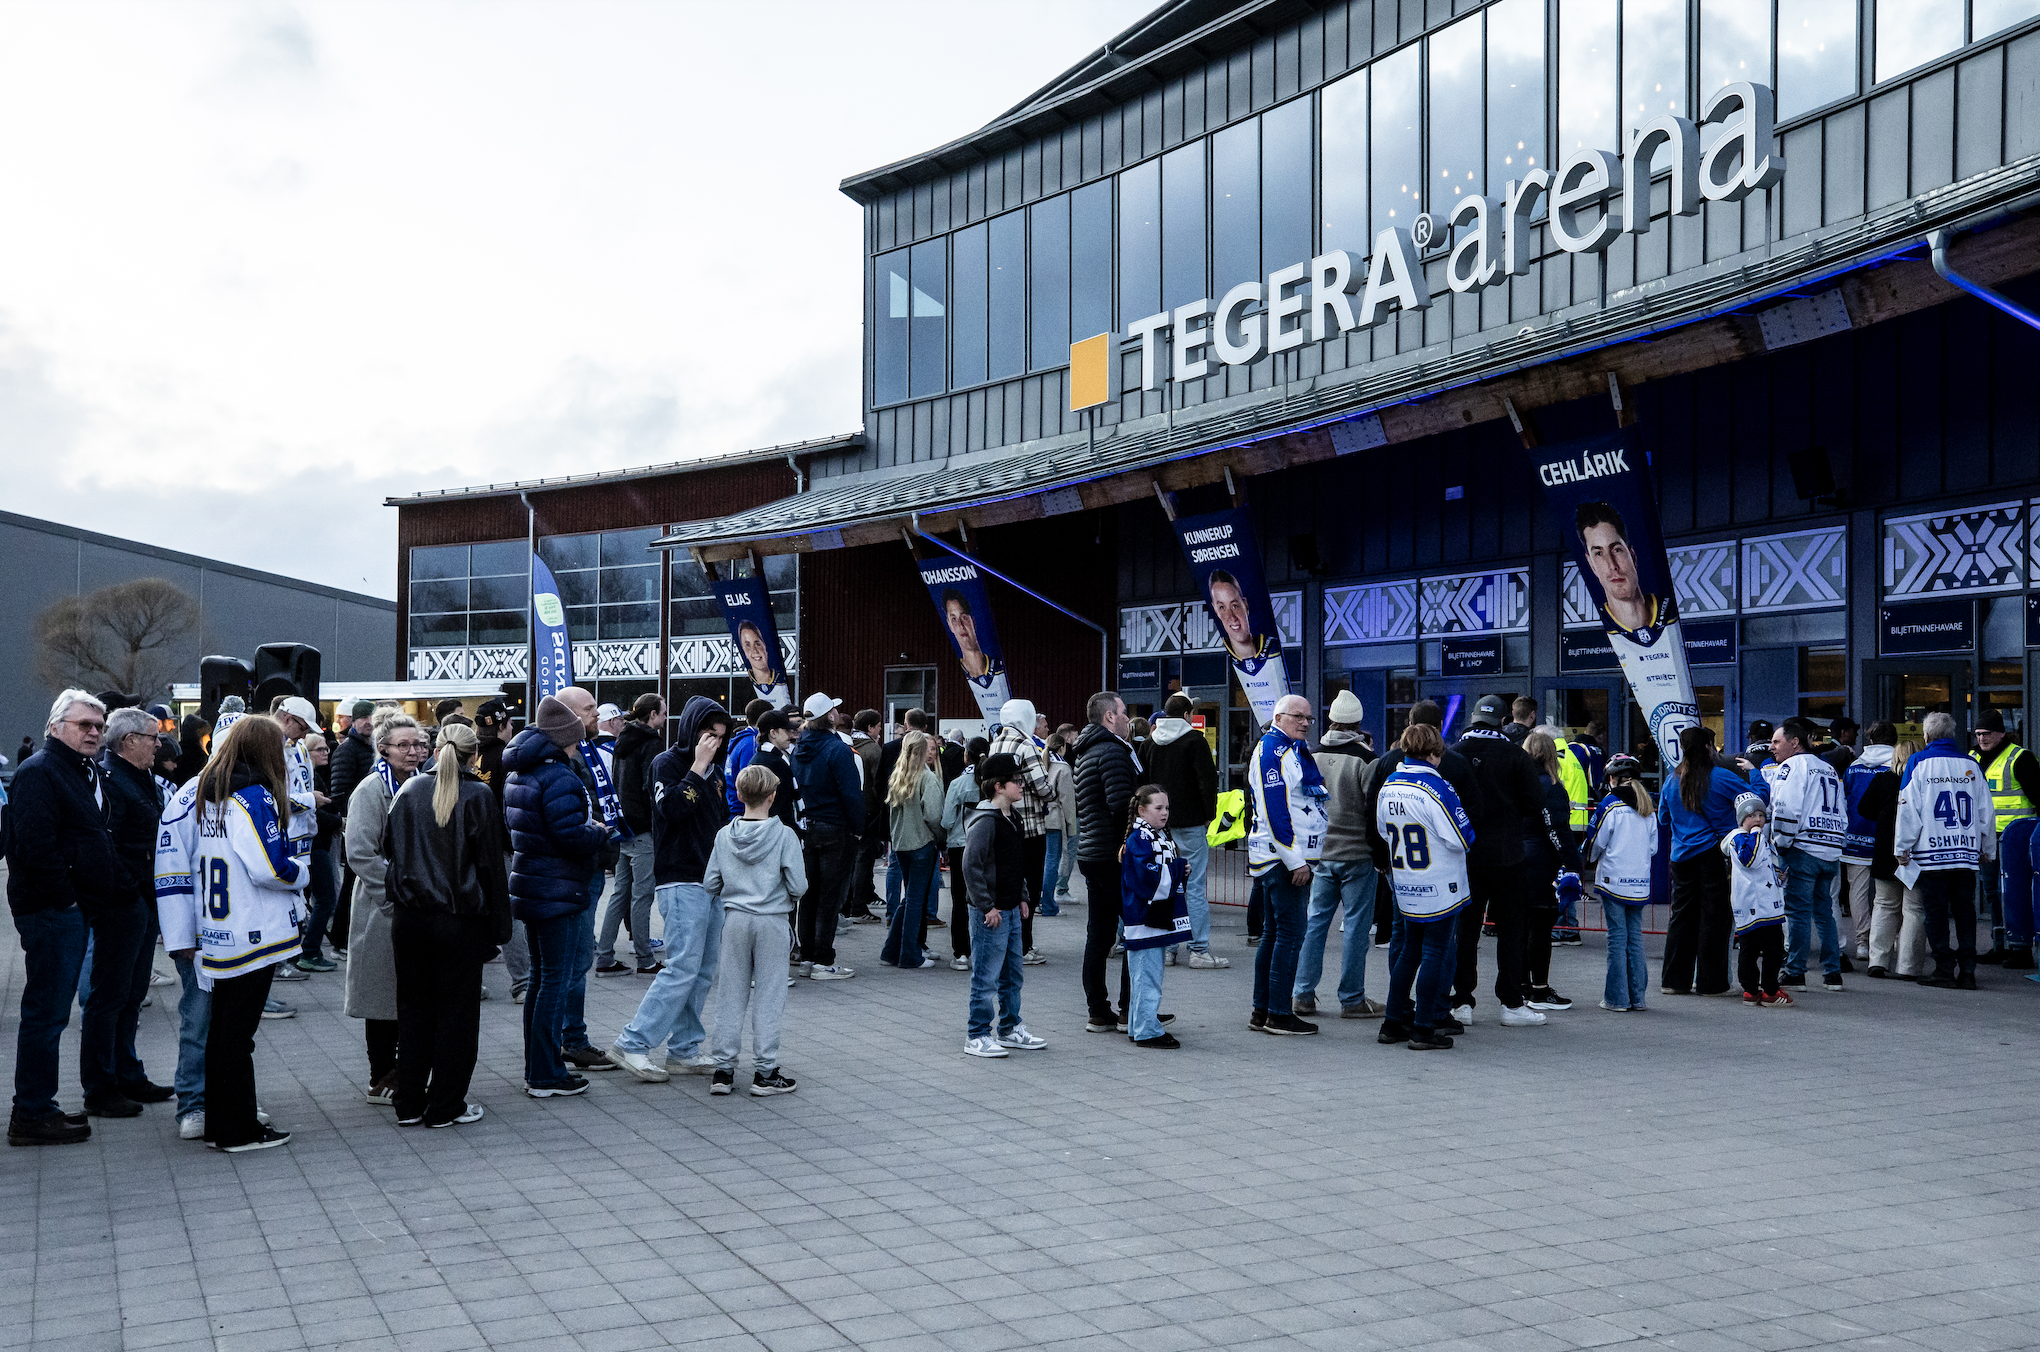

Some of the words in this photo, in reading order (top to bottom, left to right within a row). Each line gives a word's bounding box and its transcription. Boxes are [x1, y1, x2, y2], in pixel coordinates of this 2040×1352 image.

[1447, 81, 1786, 293] arena
[1539, 449, 1630, 487] CEHLÁRIK
[1183, 524, 1234, 545] KUNNERUP
[1191, 543, 1240, 563] SØRENSEN
[1890, 622, 1963, 636] BILJETTINNEHAVARE
[1568, 646, 1614, 657] BILJETTINNEHAVA
[1685, 638, 1728, 649] TTINNEHAVARE
[1448, 650, 1495, 661] BILJETTINNEHAVARE
[1657, 702, 1698, 717] IDROTTS
[1388, 801, 1406, 816] EVA
[1933, 790, 1974, 830] 40
[200, 819, 228, 839] ILSSON
[1809, 816, 1844, 831] BERGSTR
[1386, 822, 1432, 871] 28
